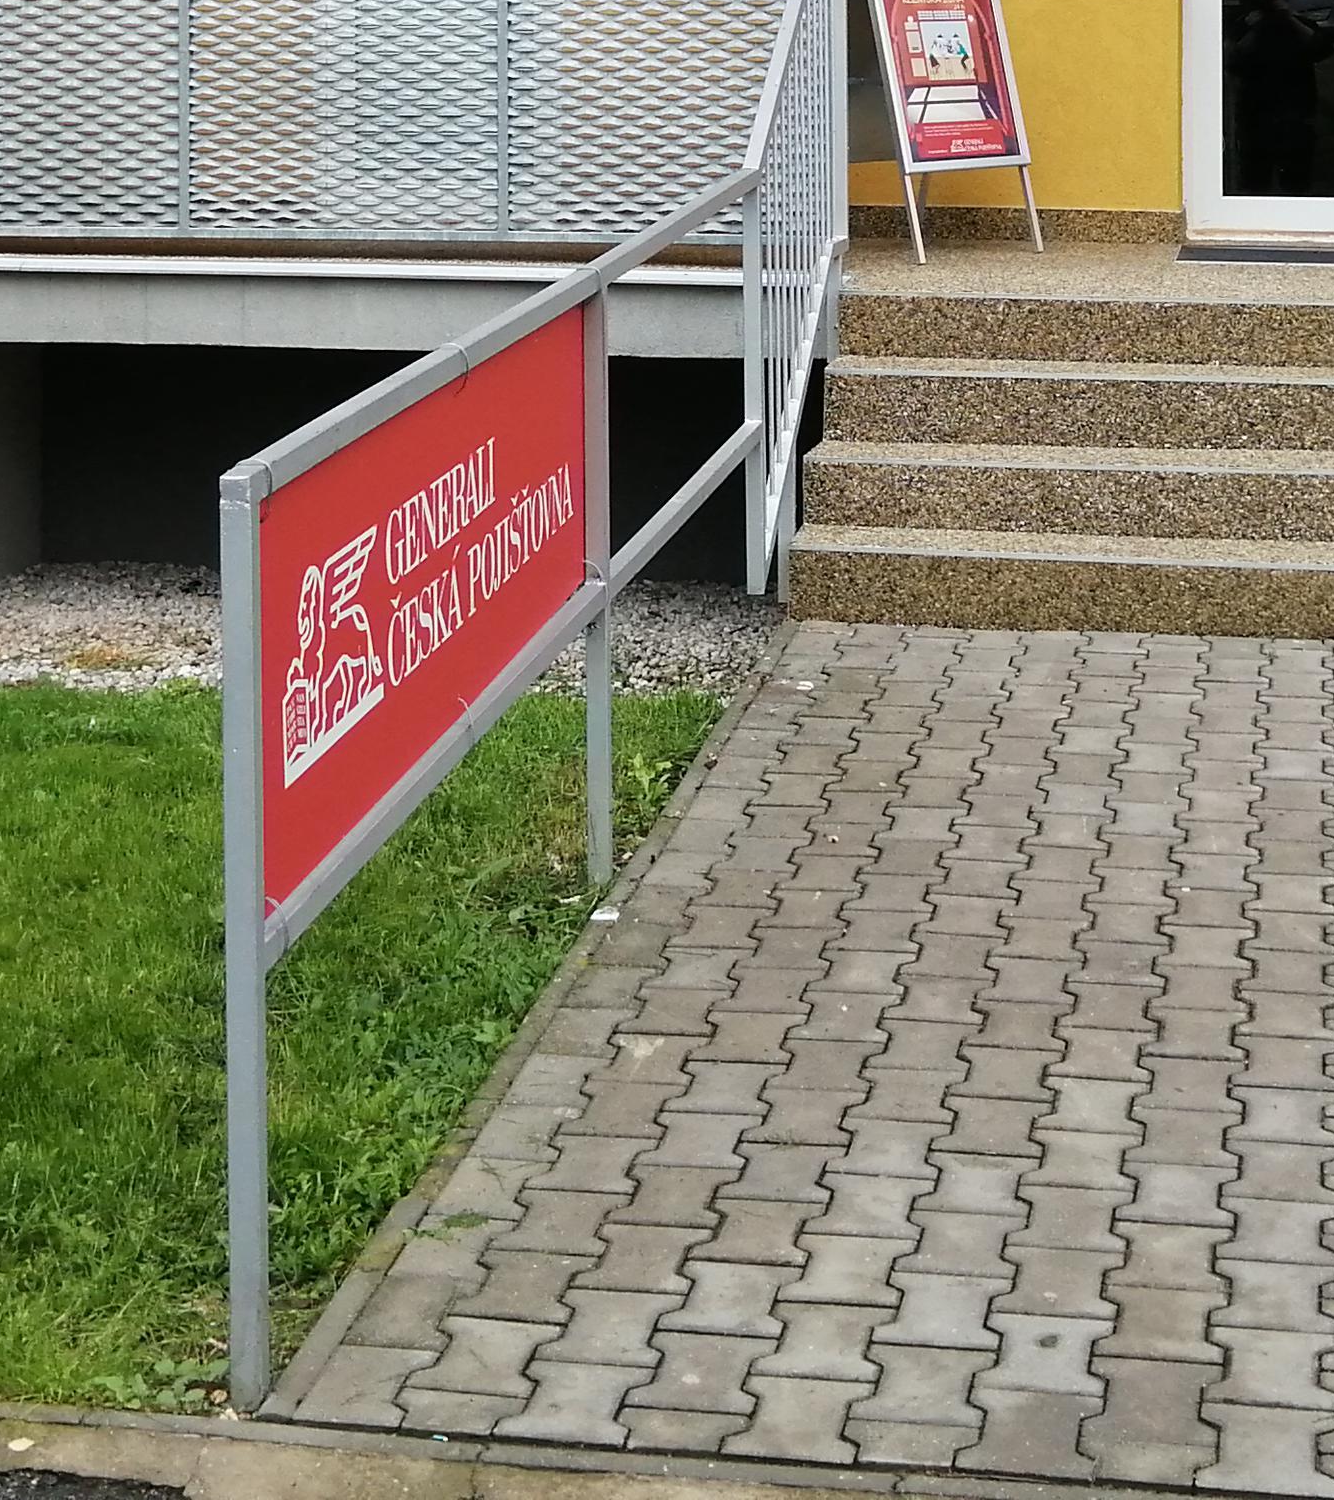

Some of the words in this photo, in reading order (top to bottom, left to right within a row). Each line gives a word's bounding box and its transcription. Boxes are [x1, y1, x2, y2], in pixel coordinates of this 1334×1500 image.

[384, 436, 497, 586] GENERALI
[387, 544, 464, 688] ČESKÁ
[467, 462, 575, 618] POJIŠŤOVNA
